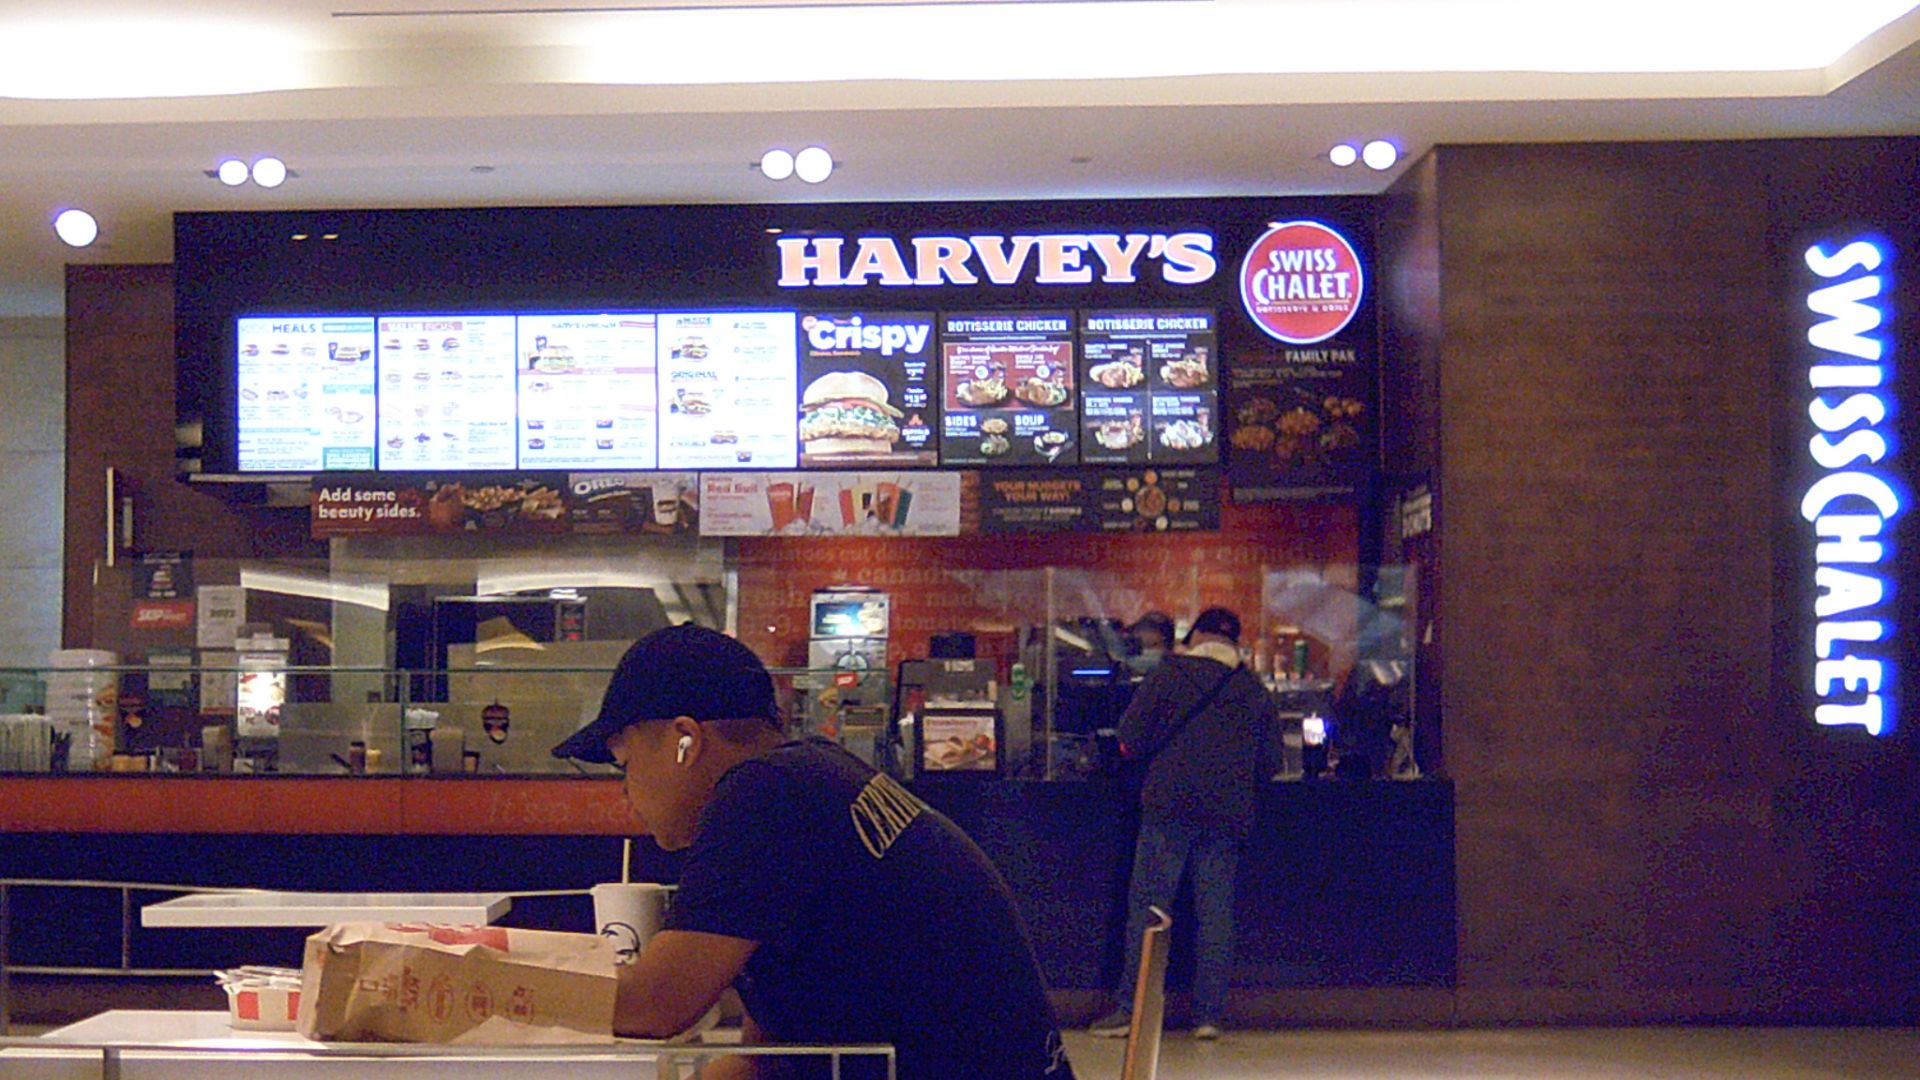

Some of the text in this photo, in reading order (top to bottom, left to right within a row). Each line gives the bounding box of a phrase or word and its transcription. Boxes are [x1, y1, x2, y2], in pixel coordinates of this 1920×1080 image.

[778, 232, 1217, 287] HARVEY'S
[1269, 248, 1336, 272] SWISS
[1252, 268, 1351, 304] CHALET
[947, 319, 1067, 332] ROTISSERIE CHICKEN
[1087, 317, 1208, 330] ROTISSERIE CHICKEN
[808, 316, 930, 356] Crispy
[1285, 349, 1329, 363] FAMILY
[1803, 241, 1886, 469] SWISS
[945, 415, 977, 427] SIDES
[1014, 414, 1045, 426] SOUP
[319, 487, 396, 502] Add some
[319, 503, 421, 522] beauty sides.
[1801, 471, 1899, 737] CHALET
